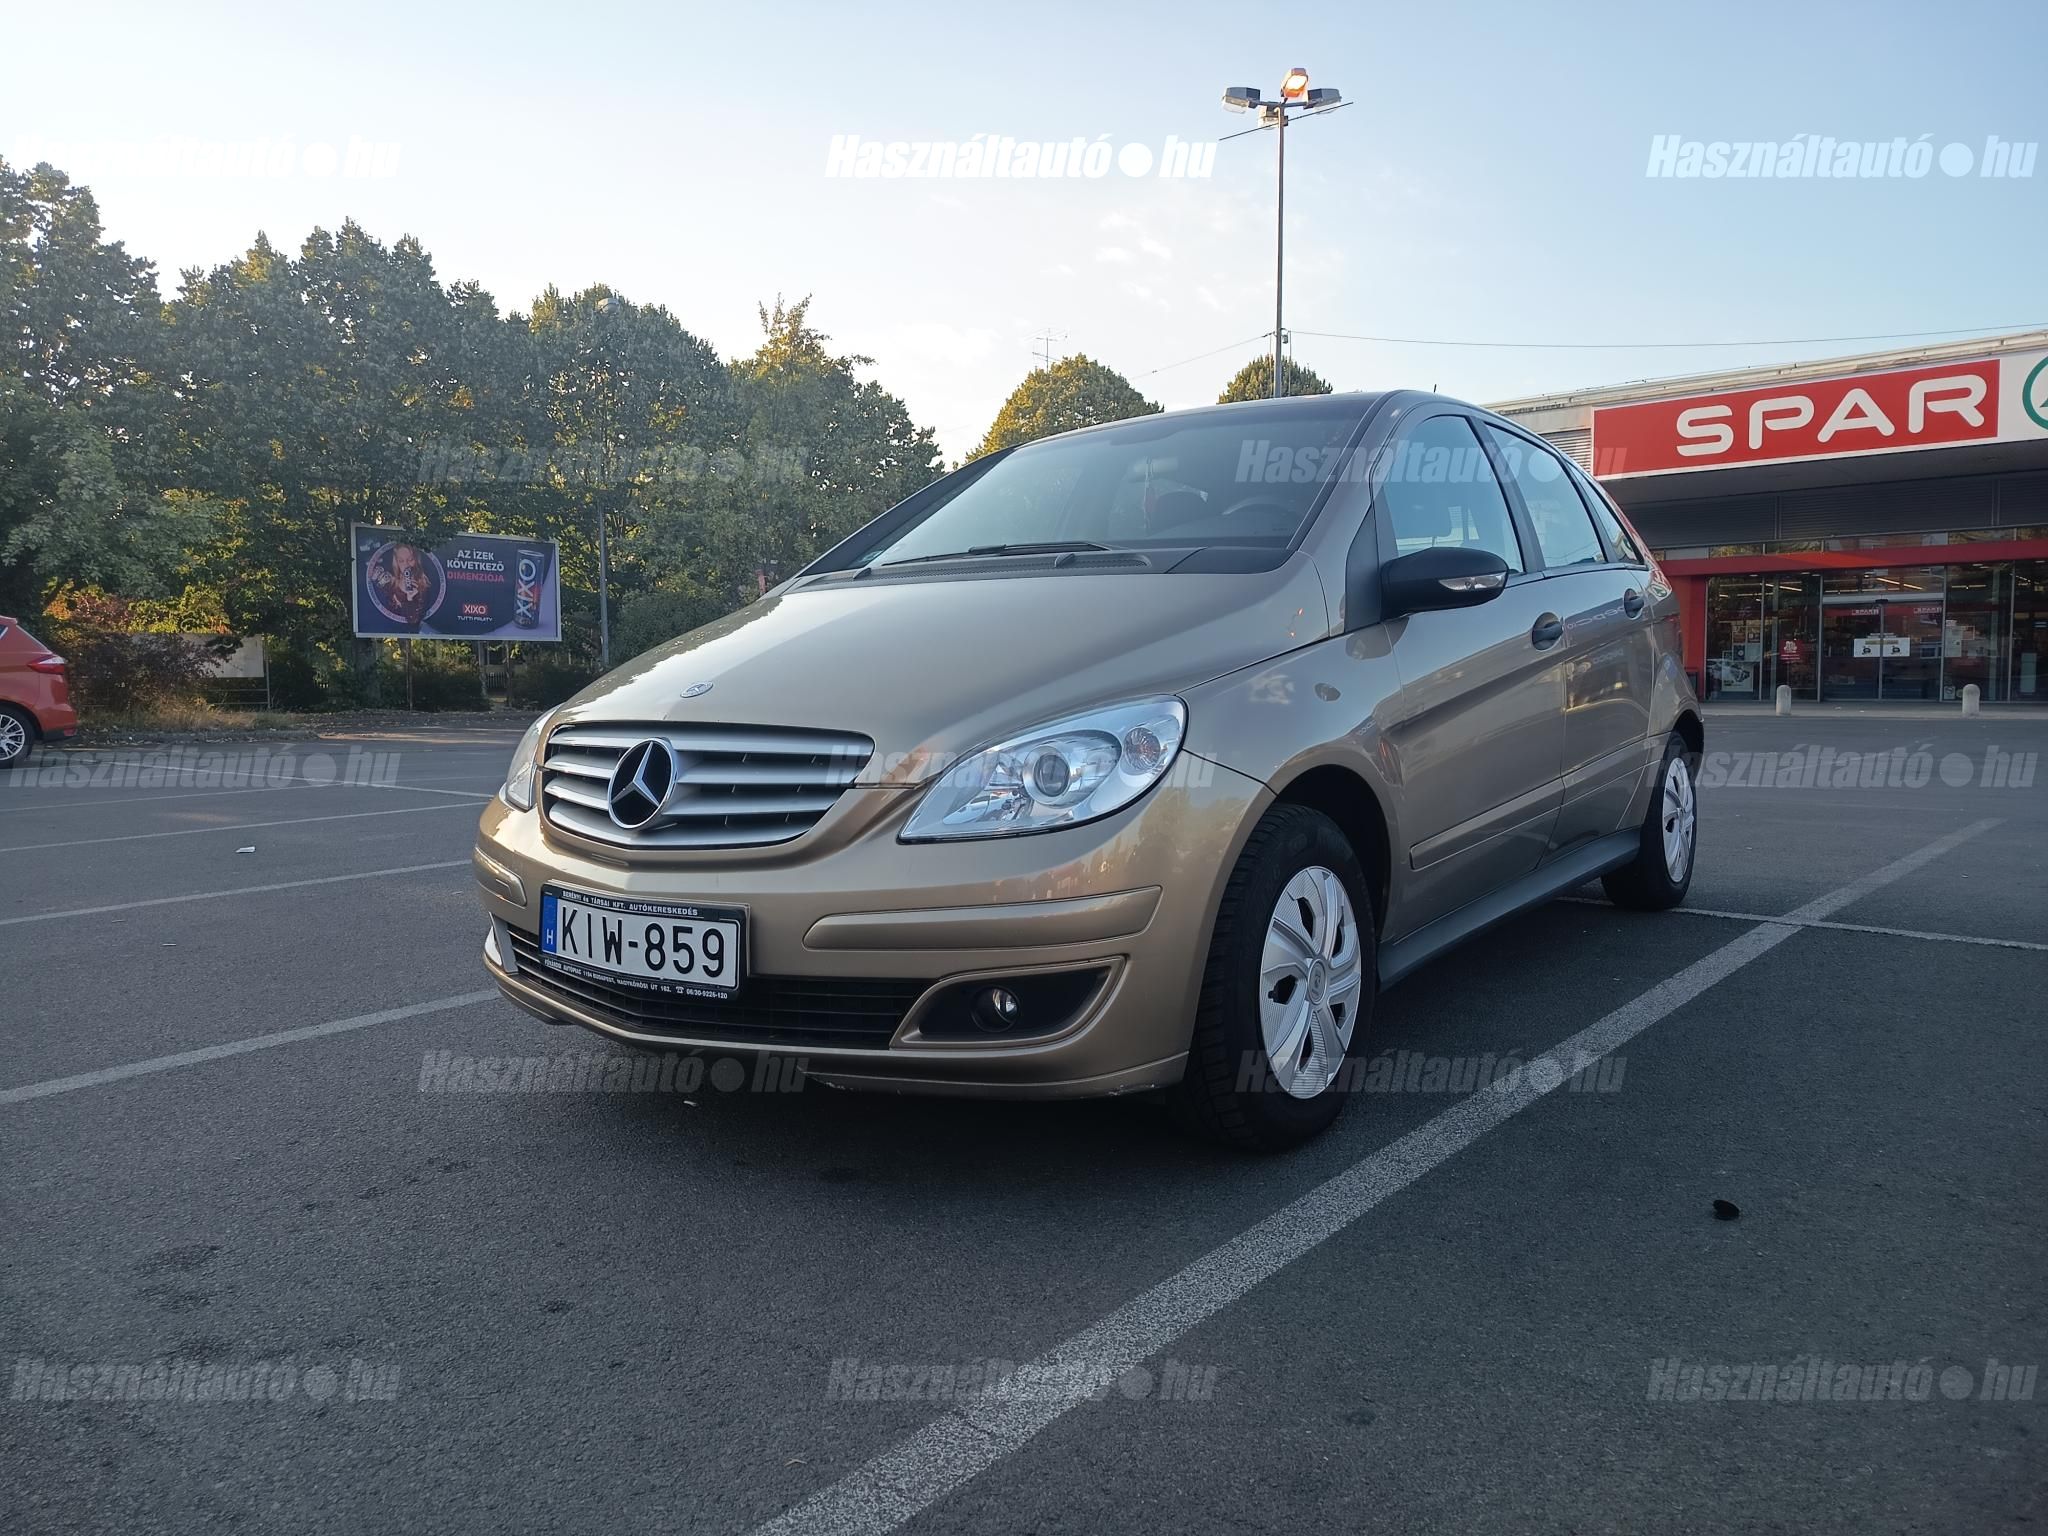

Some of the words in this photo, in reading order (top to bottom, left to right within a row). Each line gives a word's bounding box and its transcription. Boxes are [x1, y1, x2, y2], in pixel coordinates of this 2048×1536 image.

[1676, 374, 1987, 457] SPAR
[457, 549, 471, 559] AZ
[473, 548, 494, 560] ÍZEK
[447, 558, 504, 571] KÖVETKEZŐ
[447, 571, 504, 582] DIMENZIÓJA
[516, 558, 536, 618] XIXO
[464, 604, 486, 614] XIXO
[591, 897, 610, 907] TÁRSAI
[612, 901, 626, 909] KFT.
[629, 903, 698, 916] AUTÓKERESKEDÉS
[546, 928, 554, 945] H
[562, 906, 725, 979] KIW-859
